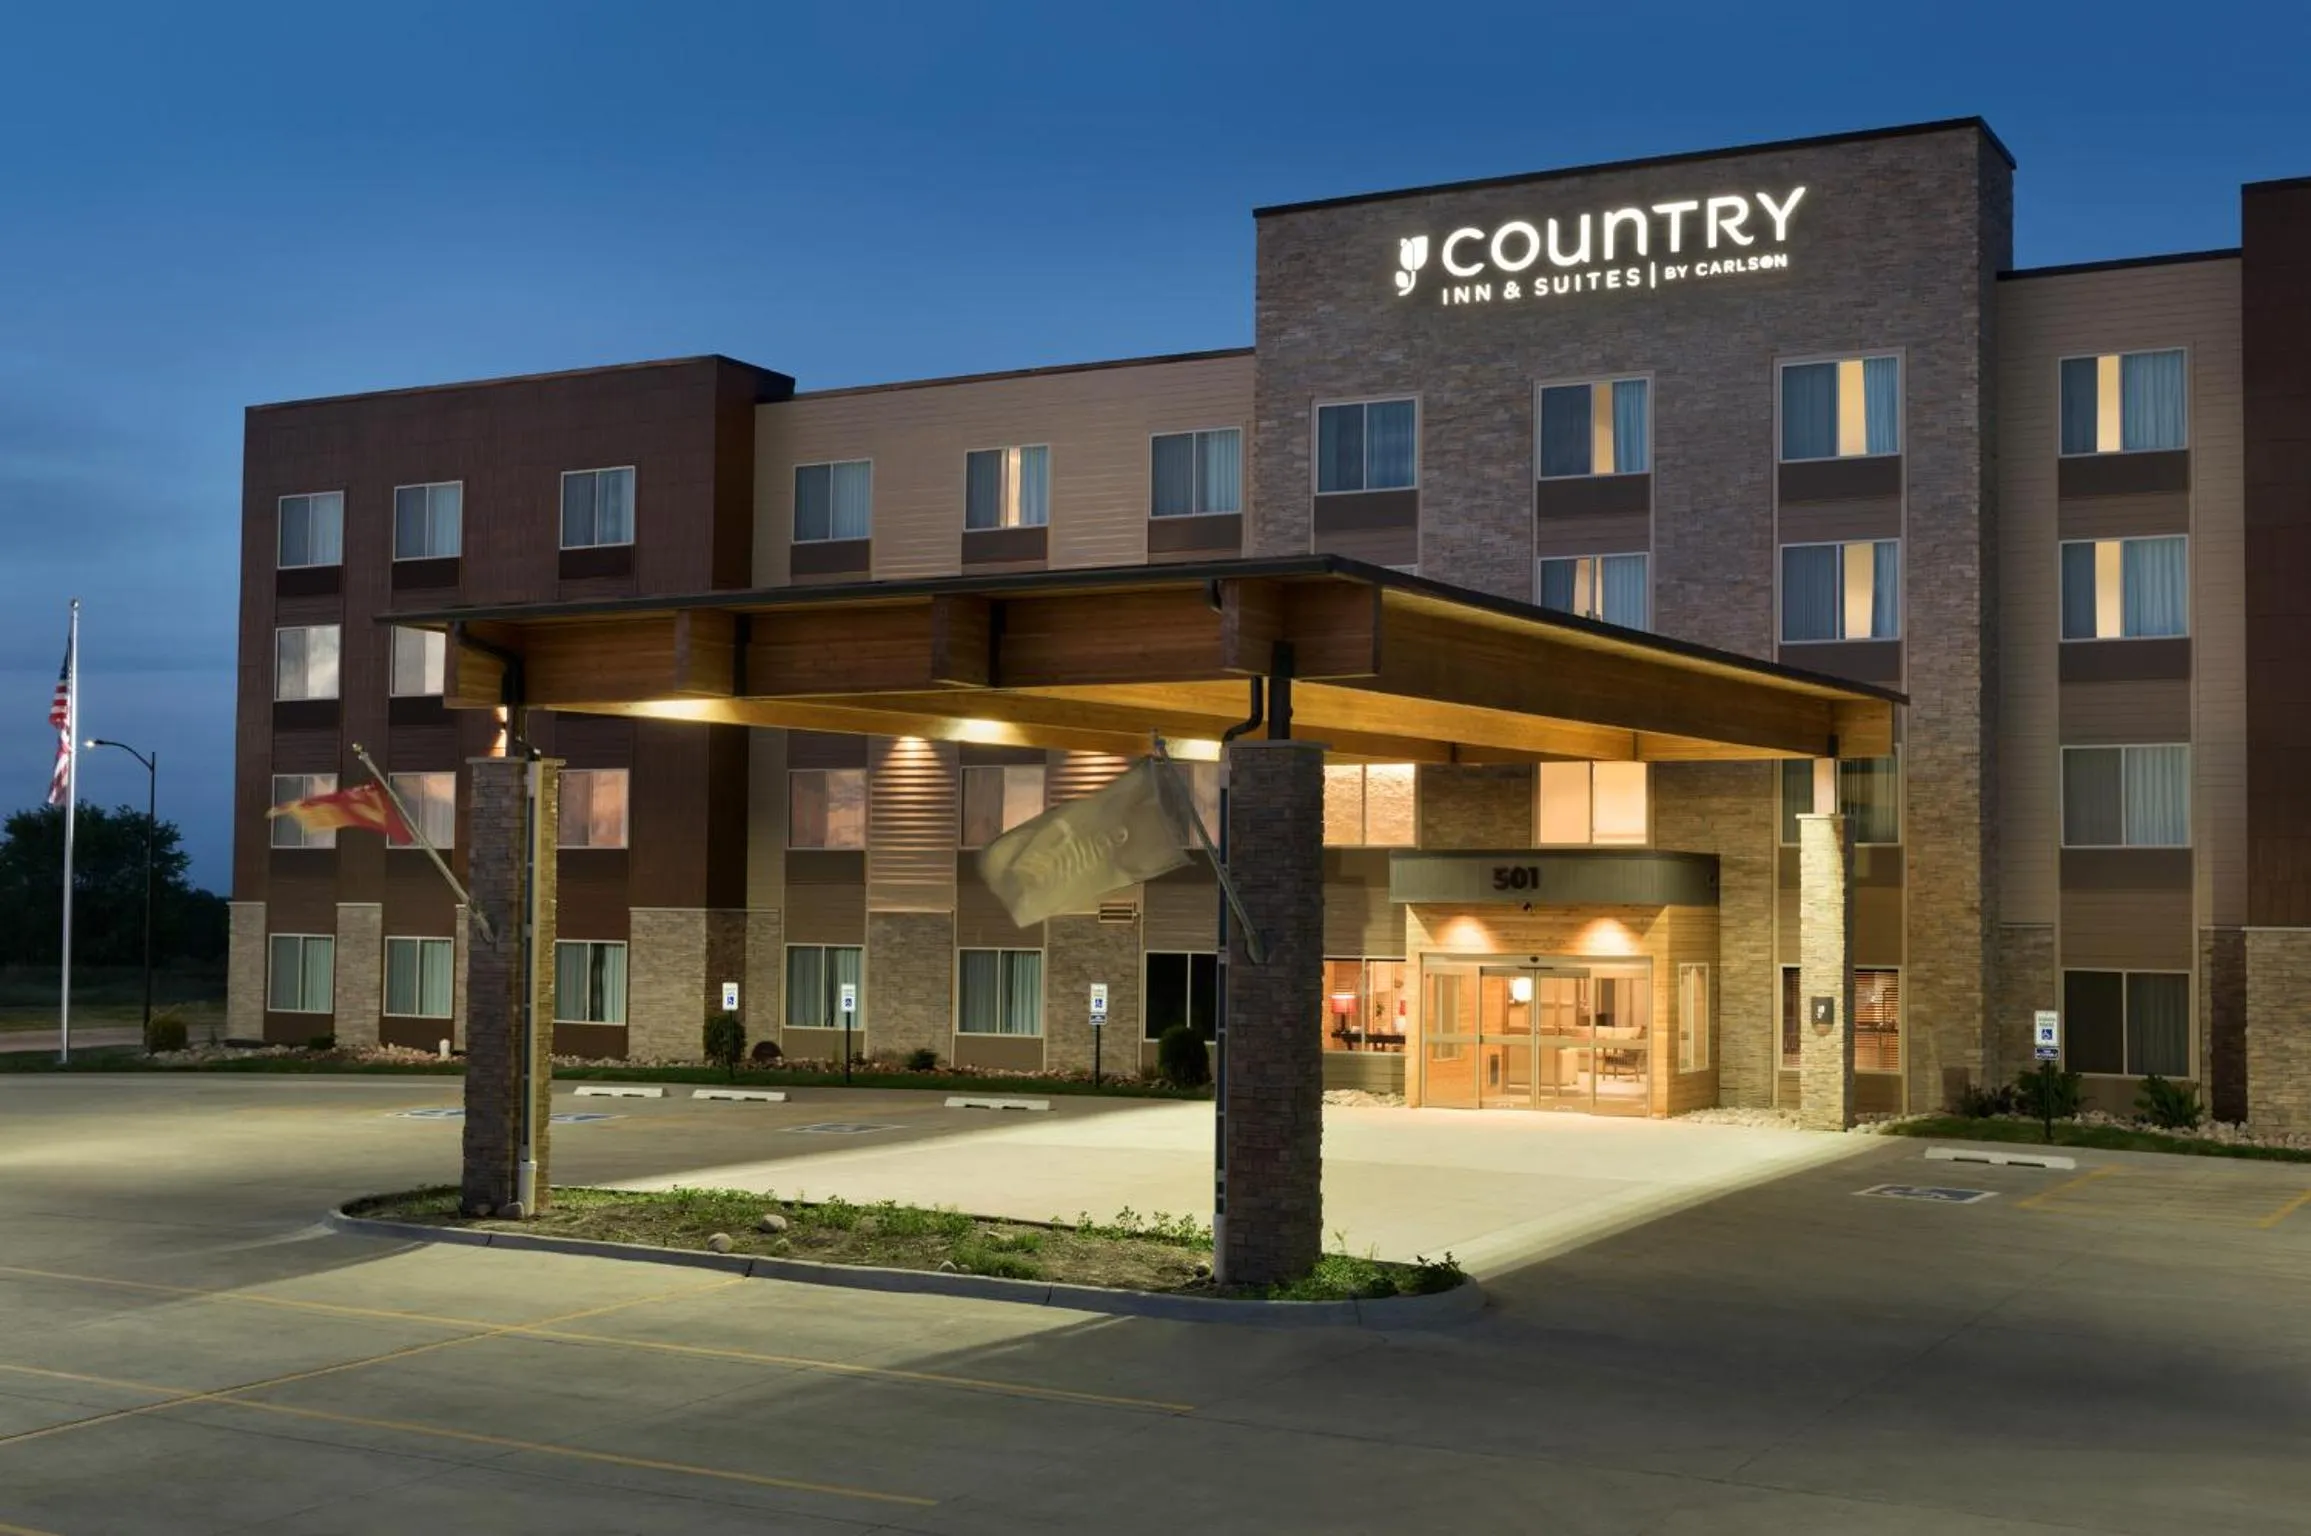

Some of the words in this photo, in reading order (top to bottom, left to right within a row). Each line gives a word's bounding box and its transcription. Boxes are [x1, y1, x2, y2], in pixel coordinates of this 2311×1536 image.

[1442, 285, 1492, 306] INN
[1502, 280, 1522, 300] &
[1534, 267, 1641, 297] SUITES
[1664, 264, 1689, 281] BY
[1694, 253, 1788, 277] CARLSON
[1492, 866, 1539, 890] 501
